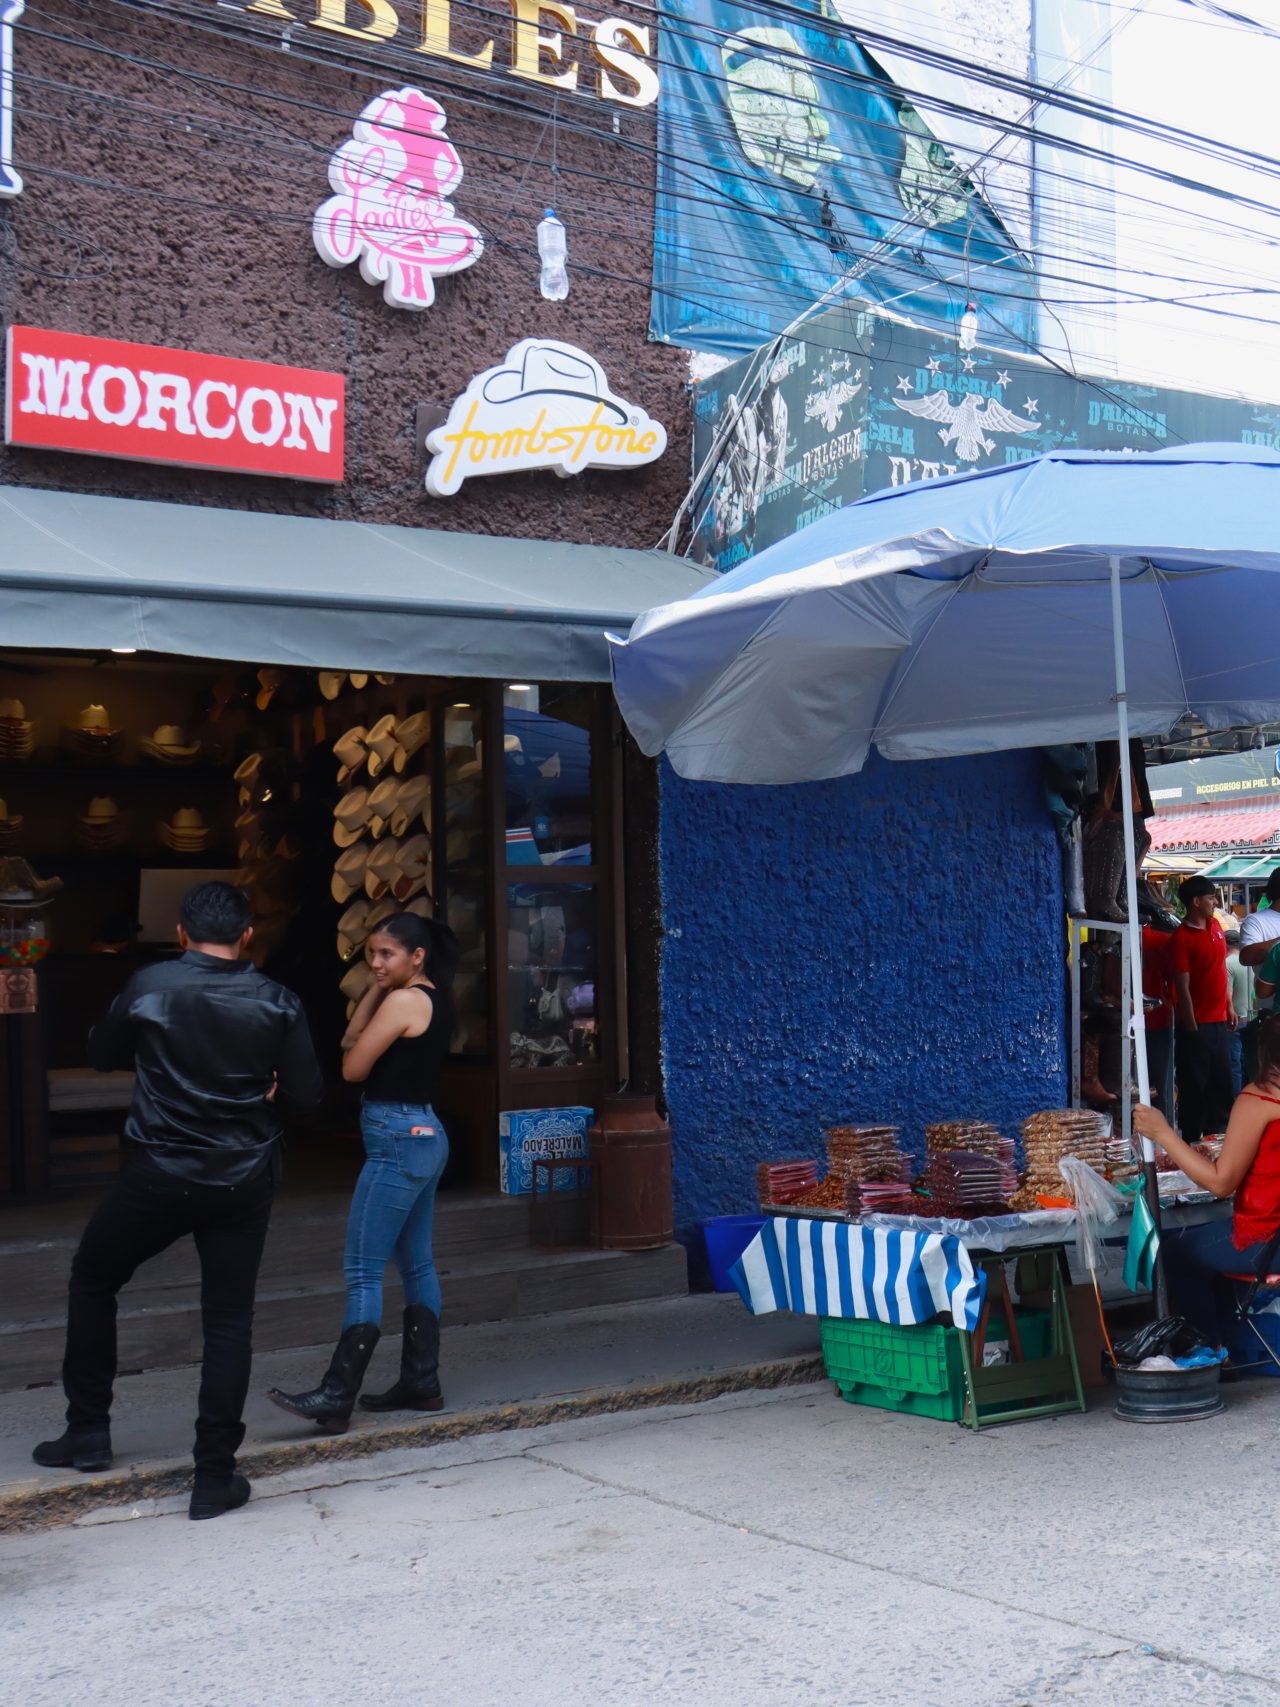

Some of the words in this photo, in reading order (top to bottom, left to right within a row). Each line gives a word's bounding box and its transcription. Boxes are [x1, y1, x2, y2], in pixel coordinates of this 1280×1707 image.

[20, 352, 337, 453] MORCON
[1107, 422, 1148, 437] BOTAS
[442, 400, 656, 484] tombstone
[812, 459, 845, 481] BOTAS
[1242, 780, 1252, 790] EN
[1253, 778, 1268, 788] PIEL
[524, 1136, 582, 1153] MALCREADO
